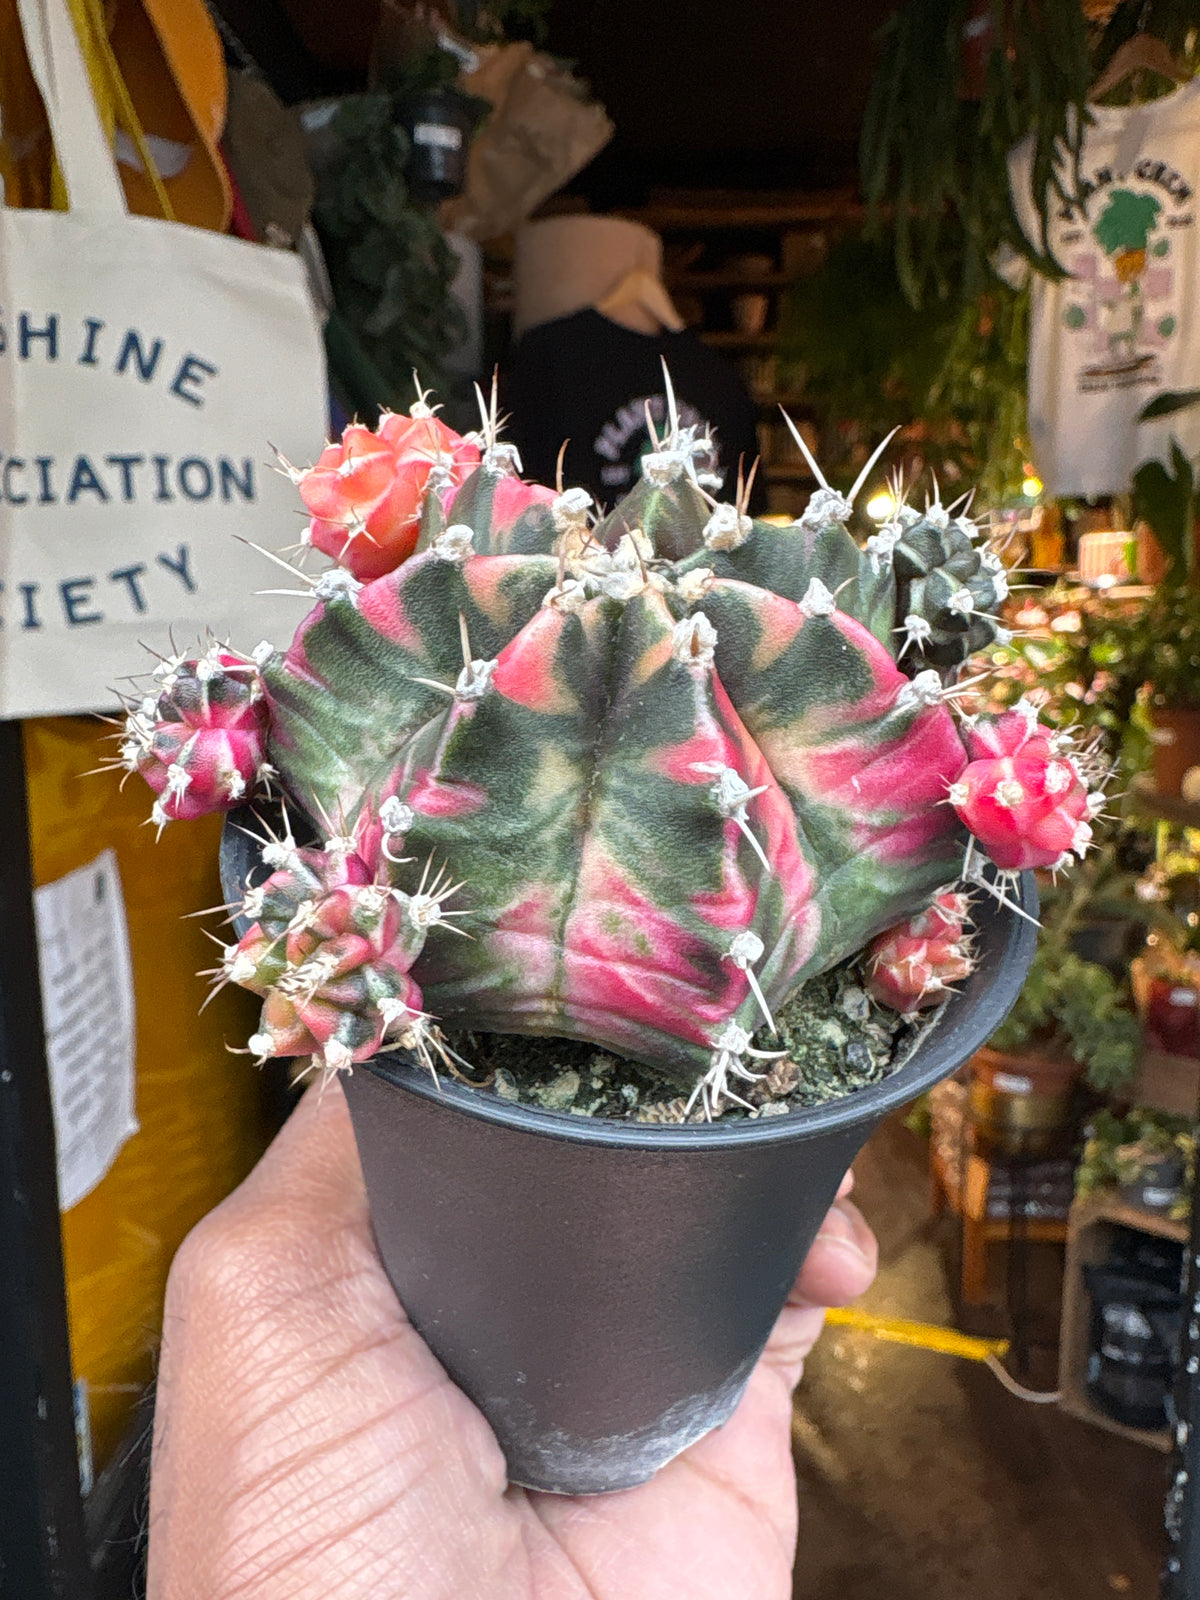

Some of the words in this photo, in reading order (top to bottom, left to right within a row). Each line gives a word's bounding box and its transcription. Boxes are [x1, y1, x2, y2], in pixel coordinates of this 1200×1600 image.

[0, 312, 219, 409] HINE
[0, 453, 257, 503] CIATION
[0, 544, 197, 630] IETY
